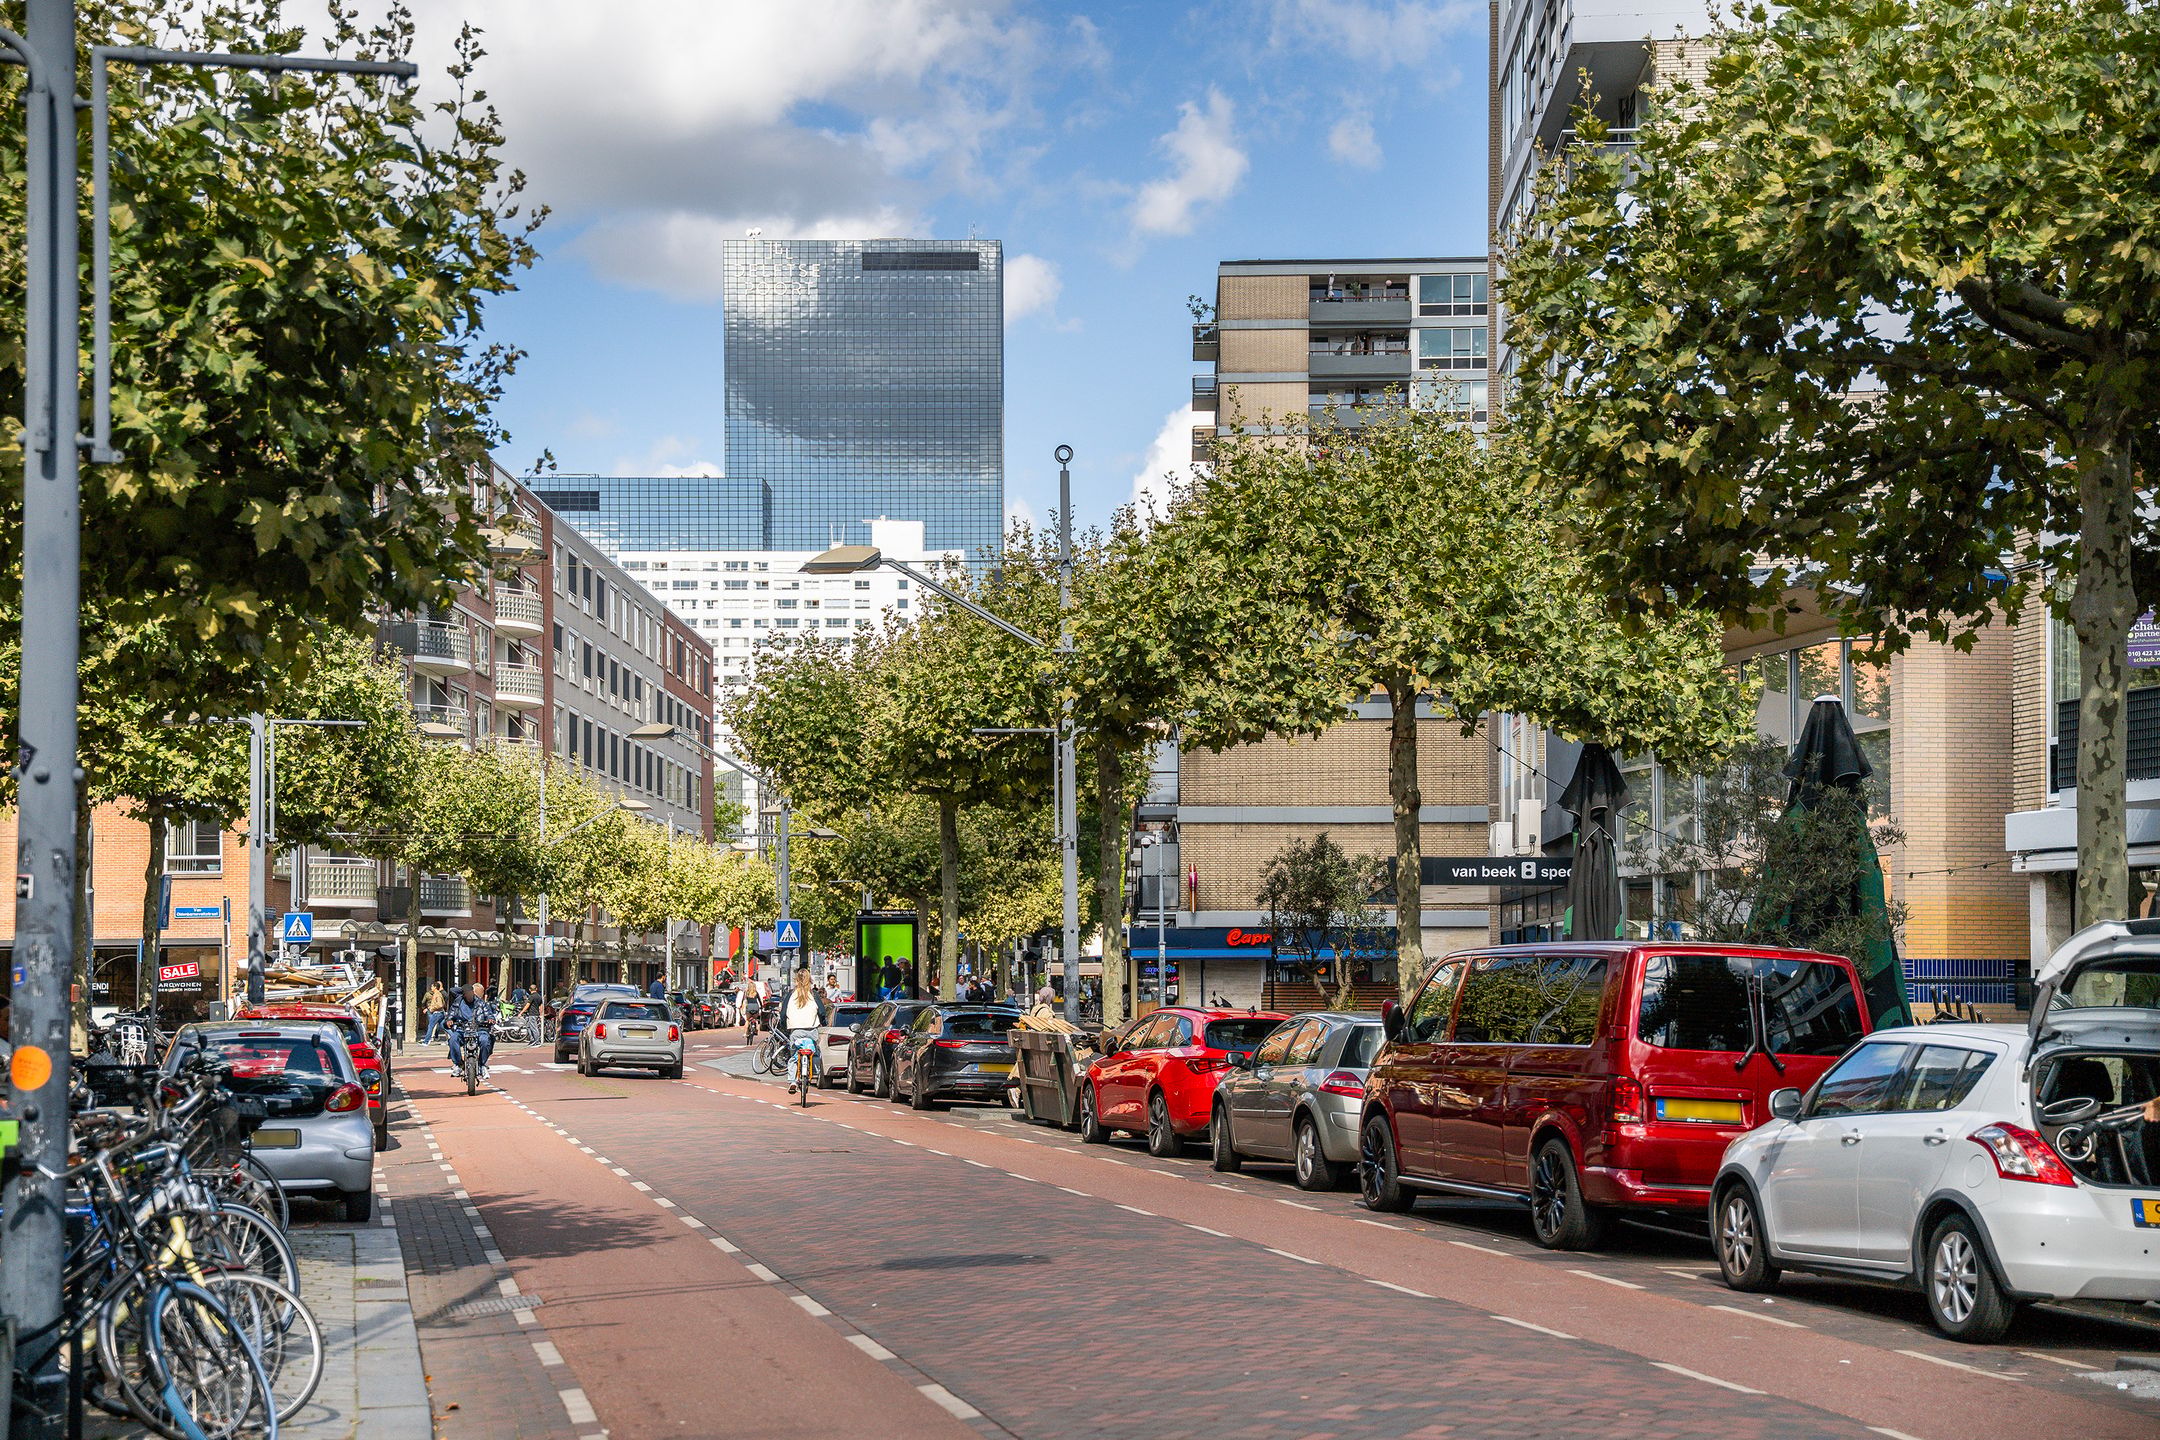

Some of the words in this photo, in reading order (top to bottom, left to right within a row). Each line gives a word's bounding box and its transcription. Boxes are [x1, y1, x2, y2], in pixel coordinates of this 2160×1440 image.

[735, 264, 820, 277] DELFTSE
[745, 281, 813, 295] POORT
[1451, 867, 1477, 878] van
[1481, 865, 1517, 878] beek
[717, 926, 725, 953] OCK
[163, 965, 196, 978] SALE
